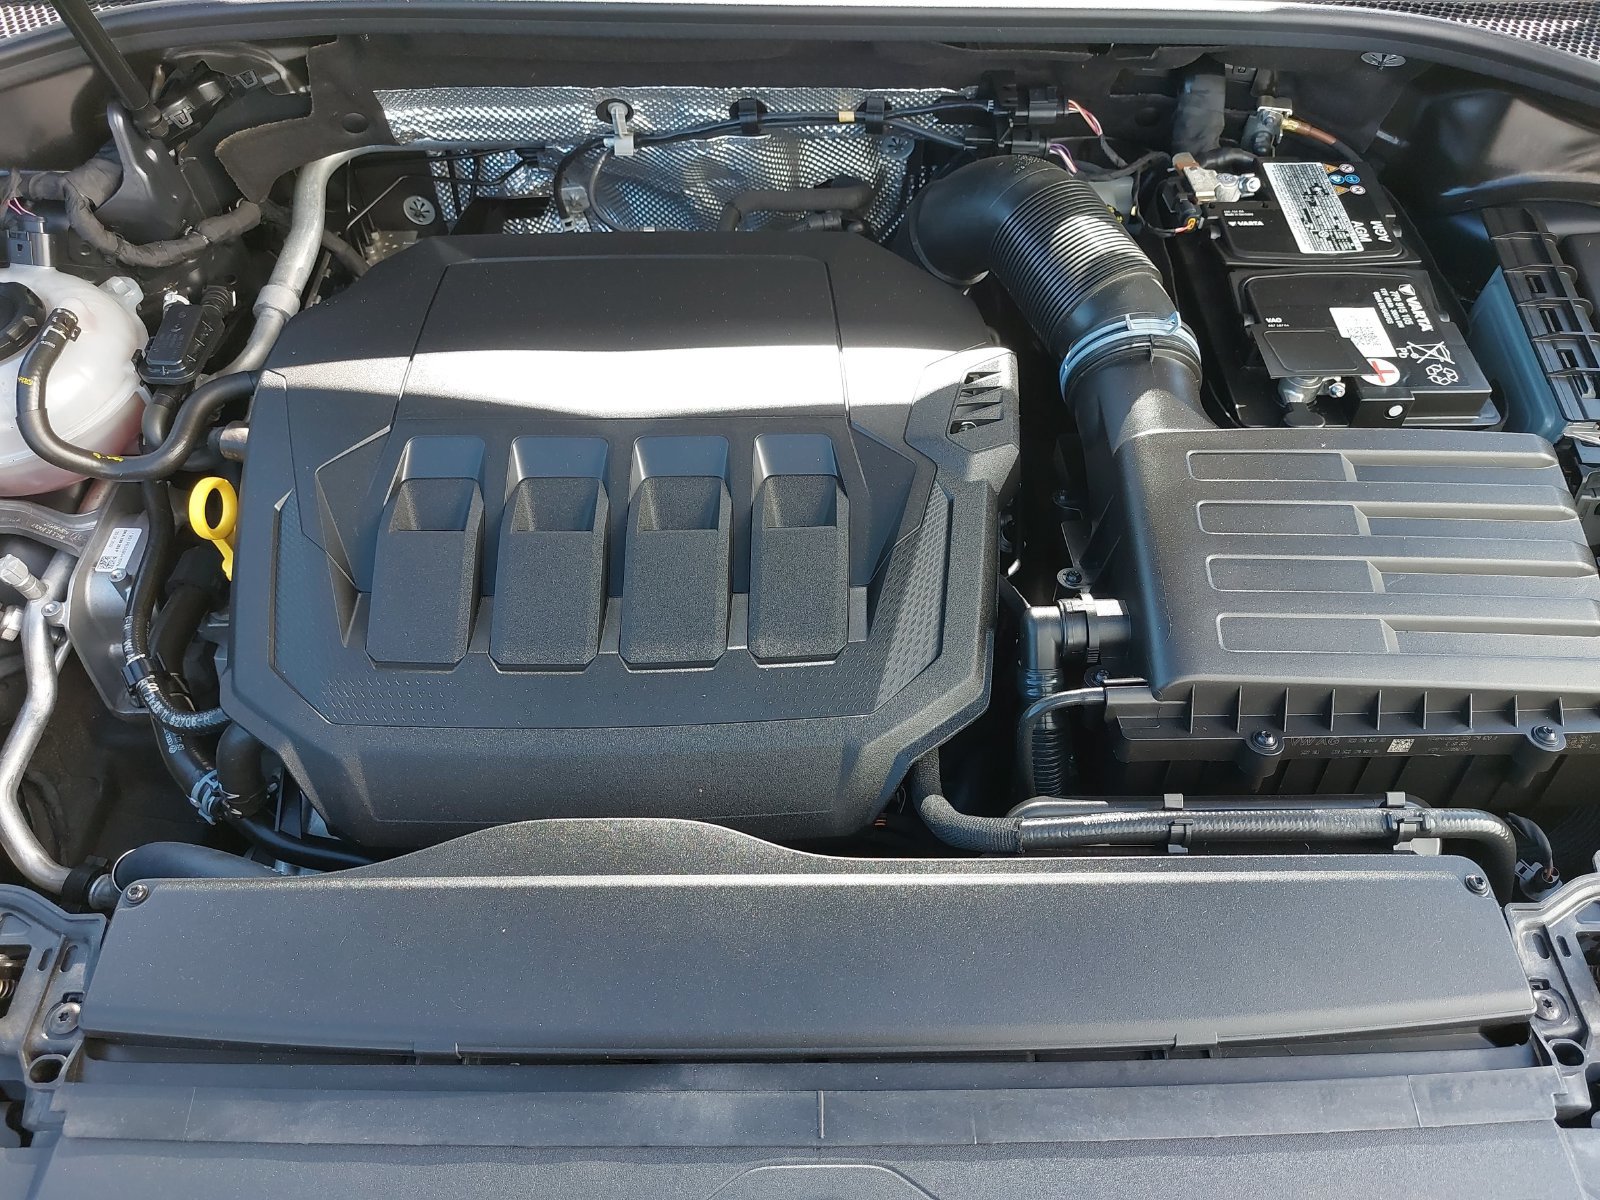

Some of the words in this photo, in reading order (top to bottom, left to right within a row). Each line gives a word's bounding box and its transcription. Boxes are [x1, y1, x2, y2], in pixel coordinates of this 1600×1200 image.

[1351, 220, 1373, 243] AGM
[1370, 220, 1392, 243] AGM
[1395, 302, 1408, 314] 915
[1406, 296, 1434, 332] VARTA
[1401, 313, 1414, 325] 105
[1396, 347, 1409, 359] Pb
